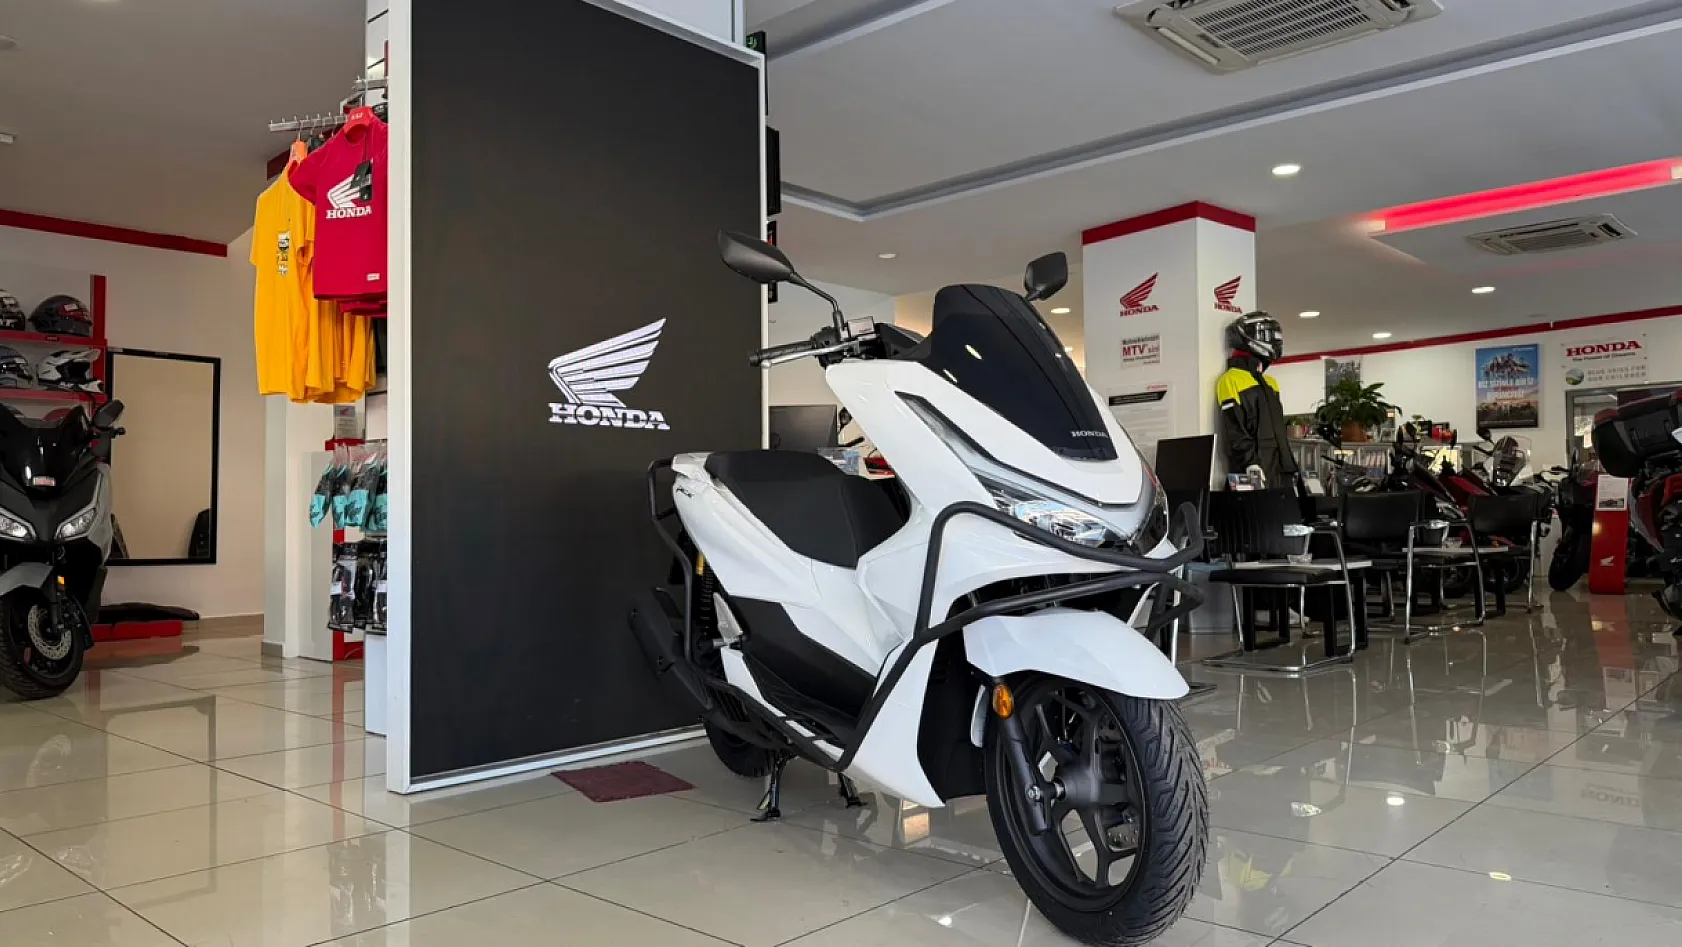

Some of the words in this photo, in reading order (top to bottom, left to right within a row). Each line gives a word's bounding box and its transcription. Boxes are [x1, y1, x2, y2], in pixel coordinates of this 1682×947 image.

[326, 206, 372, 219] HONDA
[1120, 304, 1159, 317] HONDA
[1213, 302, 1242, 313] HONDA
[1566, 340, 1642, 357] HONDA
[547, 402, 671, 430] HONDA
[1071, 430, 1109, 439] HONDA
